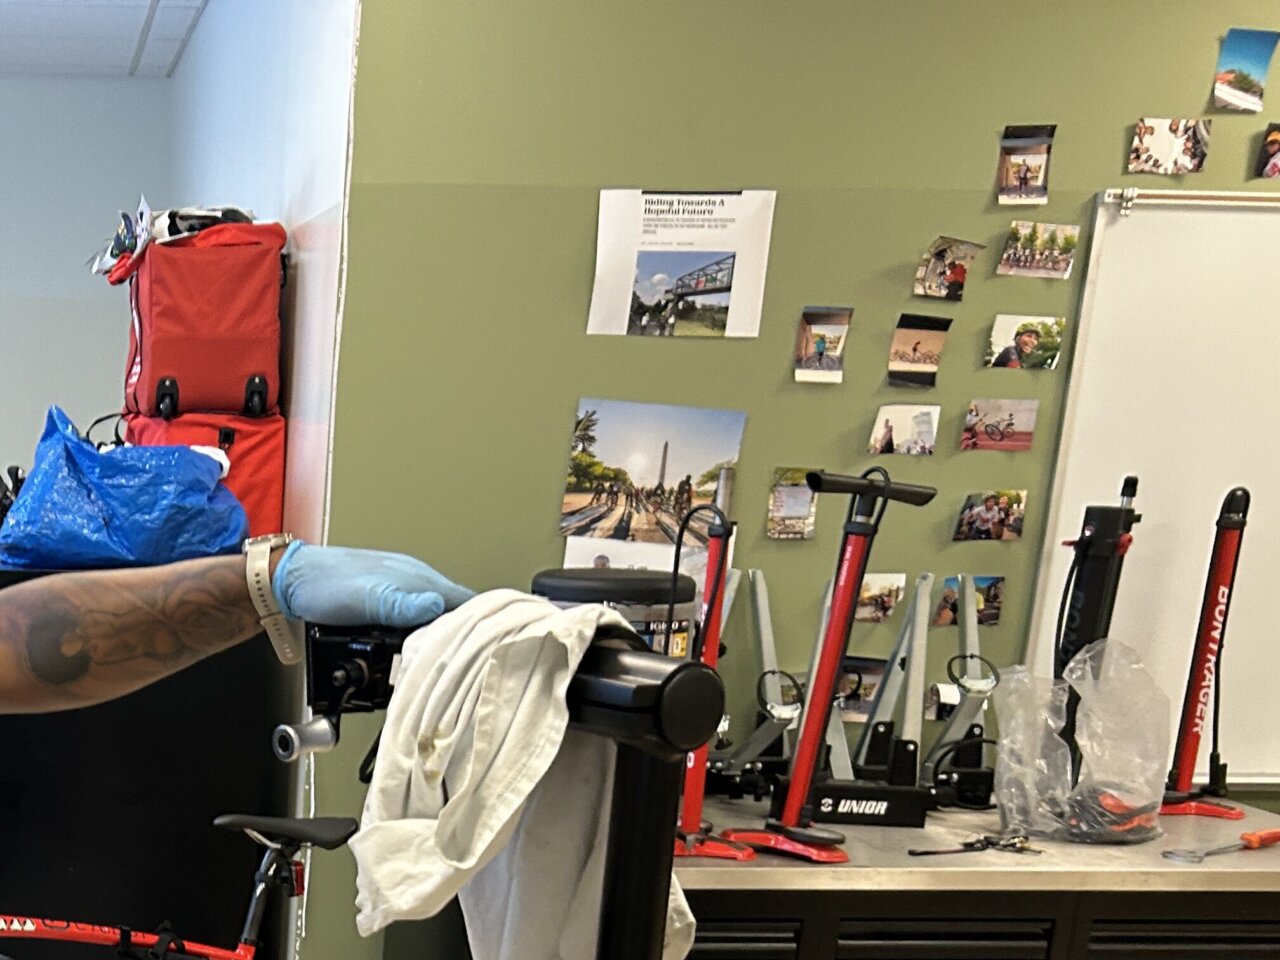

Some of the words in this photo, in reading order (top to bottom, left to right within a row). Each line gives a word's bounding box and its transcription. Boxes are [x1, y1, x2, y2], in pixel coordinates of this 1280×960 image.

[643, 198, 674, 208] Riding
[643, 207, 680, 216] Hopeful
[681, 208, 714, 216] Future
[837, 798, 888, 815] UNIOR
